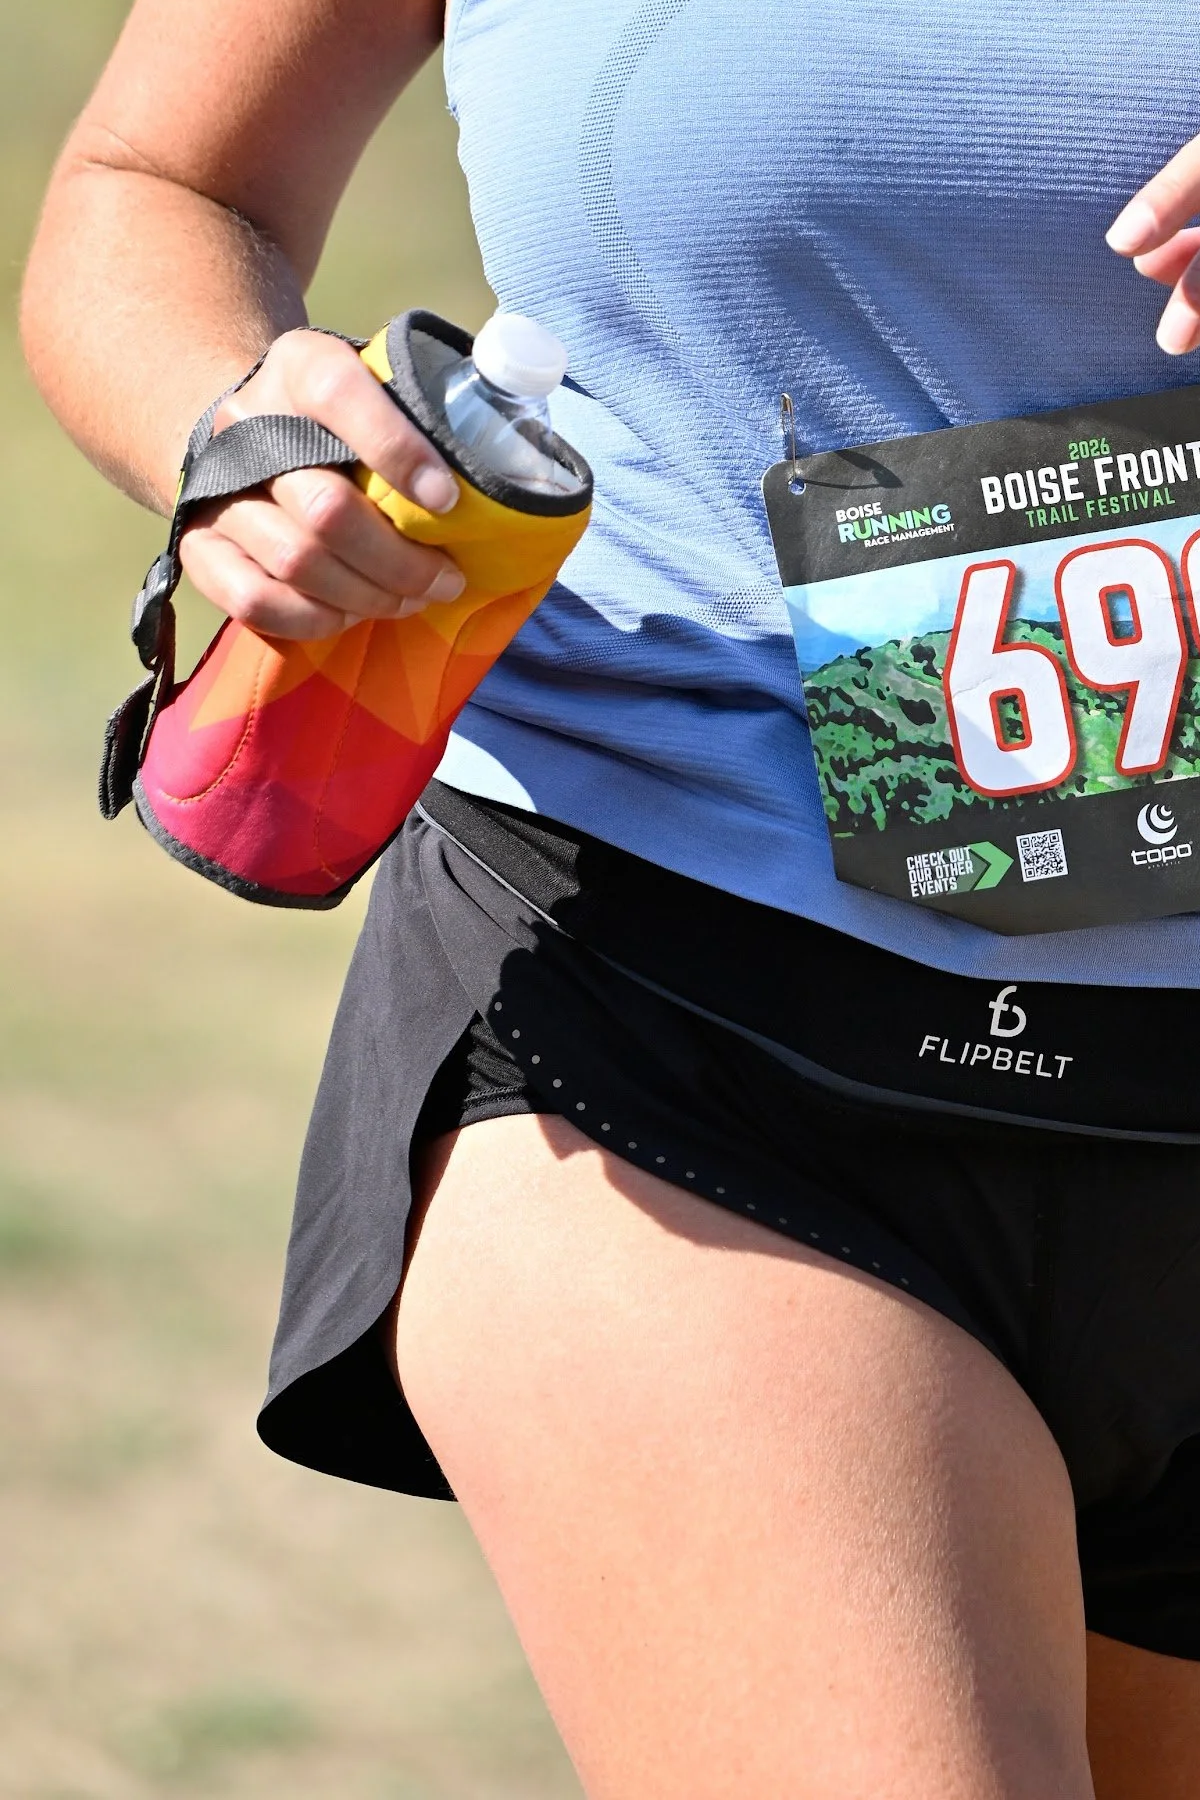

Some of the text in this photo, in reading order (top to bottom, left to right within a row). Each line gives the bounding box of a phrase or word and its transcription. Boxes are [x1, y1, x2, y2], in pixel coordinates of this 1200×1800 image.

[1068, 437, 1111, 461] 2026
[980, 461, 1083, 514] BOISE
[835, 501, 883, 523] BOISE
[1025, 487, 1176, 529] TRAIL FESTIVAL
[837, 503, 952, 543] RUNNING
[864, 523, 955, 548] RACE MANAGEMENT
[906, 846, 971, 871] CHECK OUT
[1131, 843, 1193, 865] topo
[908, 860, 974, 884] OUR OTHER
[911, 876, 957, 897] EVENTS
[918, 1034, 1074, 1080] FLIPBELT
